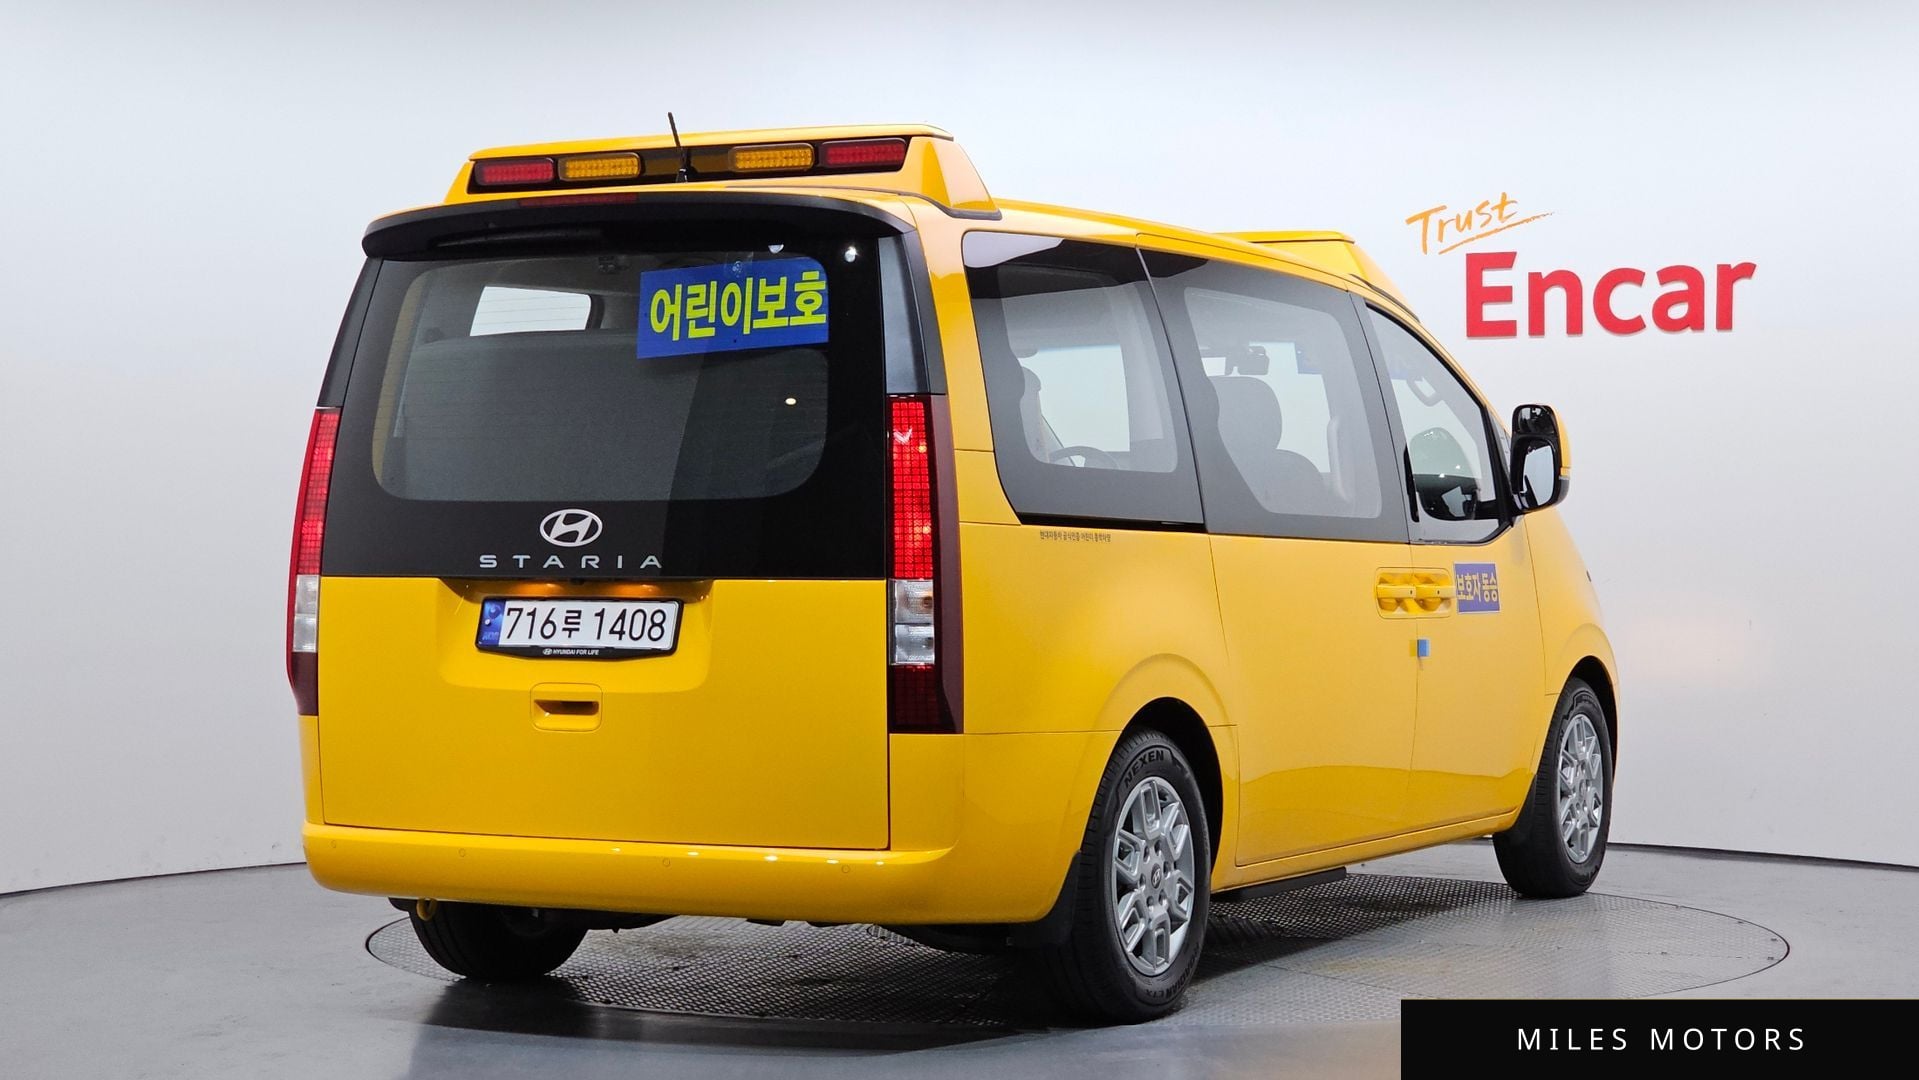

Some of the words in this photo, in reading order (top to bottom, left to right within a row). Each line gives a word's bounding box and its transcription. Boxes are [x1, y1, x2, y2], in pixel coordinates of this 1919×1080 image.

[1405, 192, 1518, 255] Trust
[650, 270, 827, 342] 어린이보호
[1465, 251, 1757, 338] Encar
[479, 554, 662, 569] STARIA
[1456, 572, 1481, 602] 보호자
[506, 607, 582, 640] 716루
[594, 607, 667, 642] 1408
[1124, 750, 1164, 788] NEXEN
